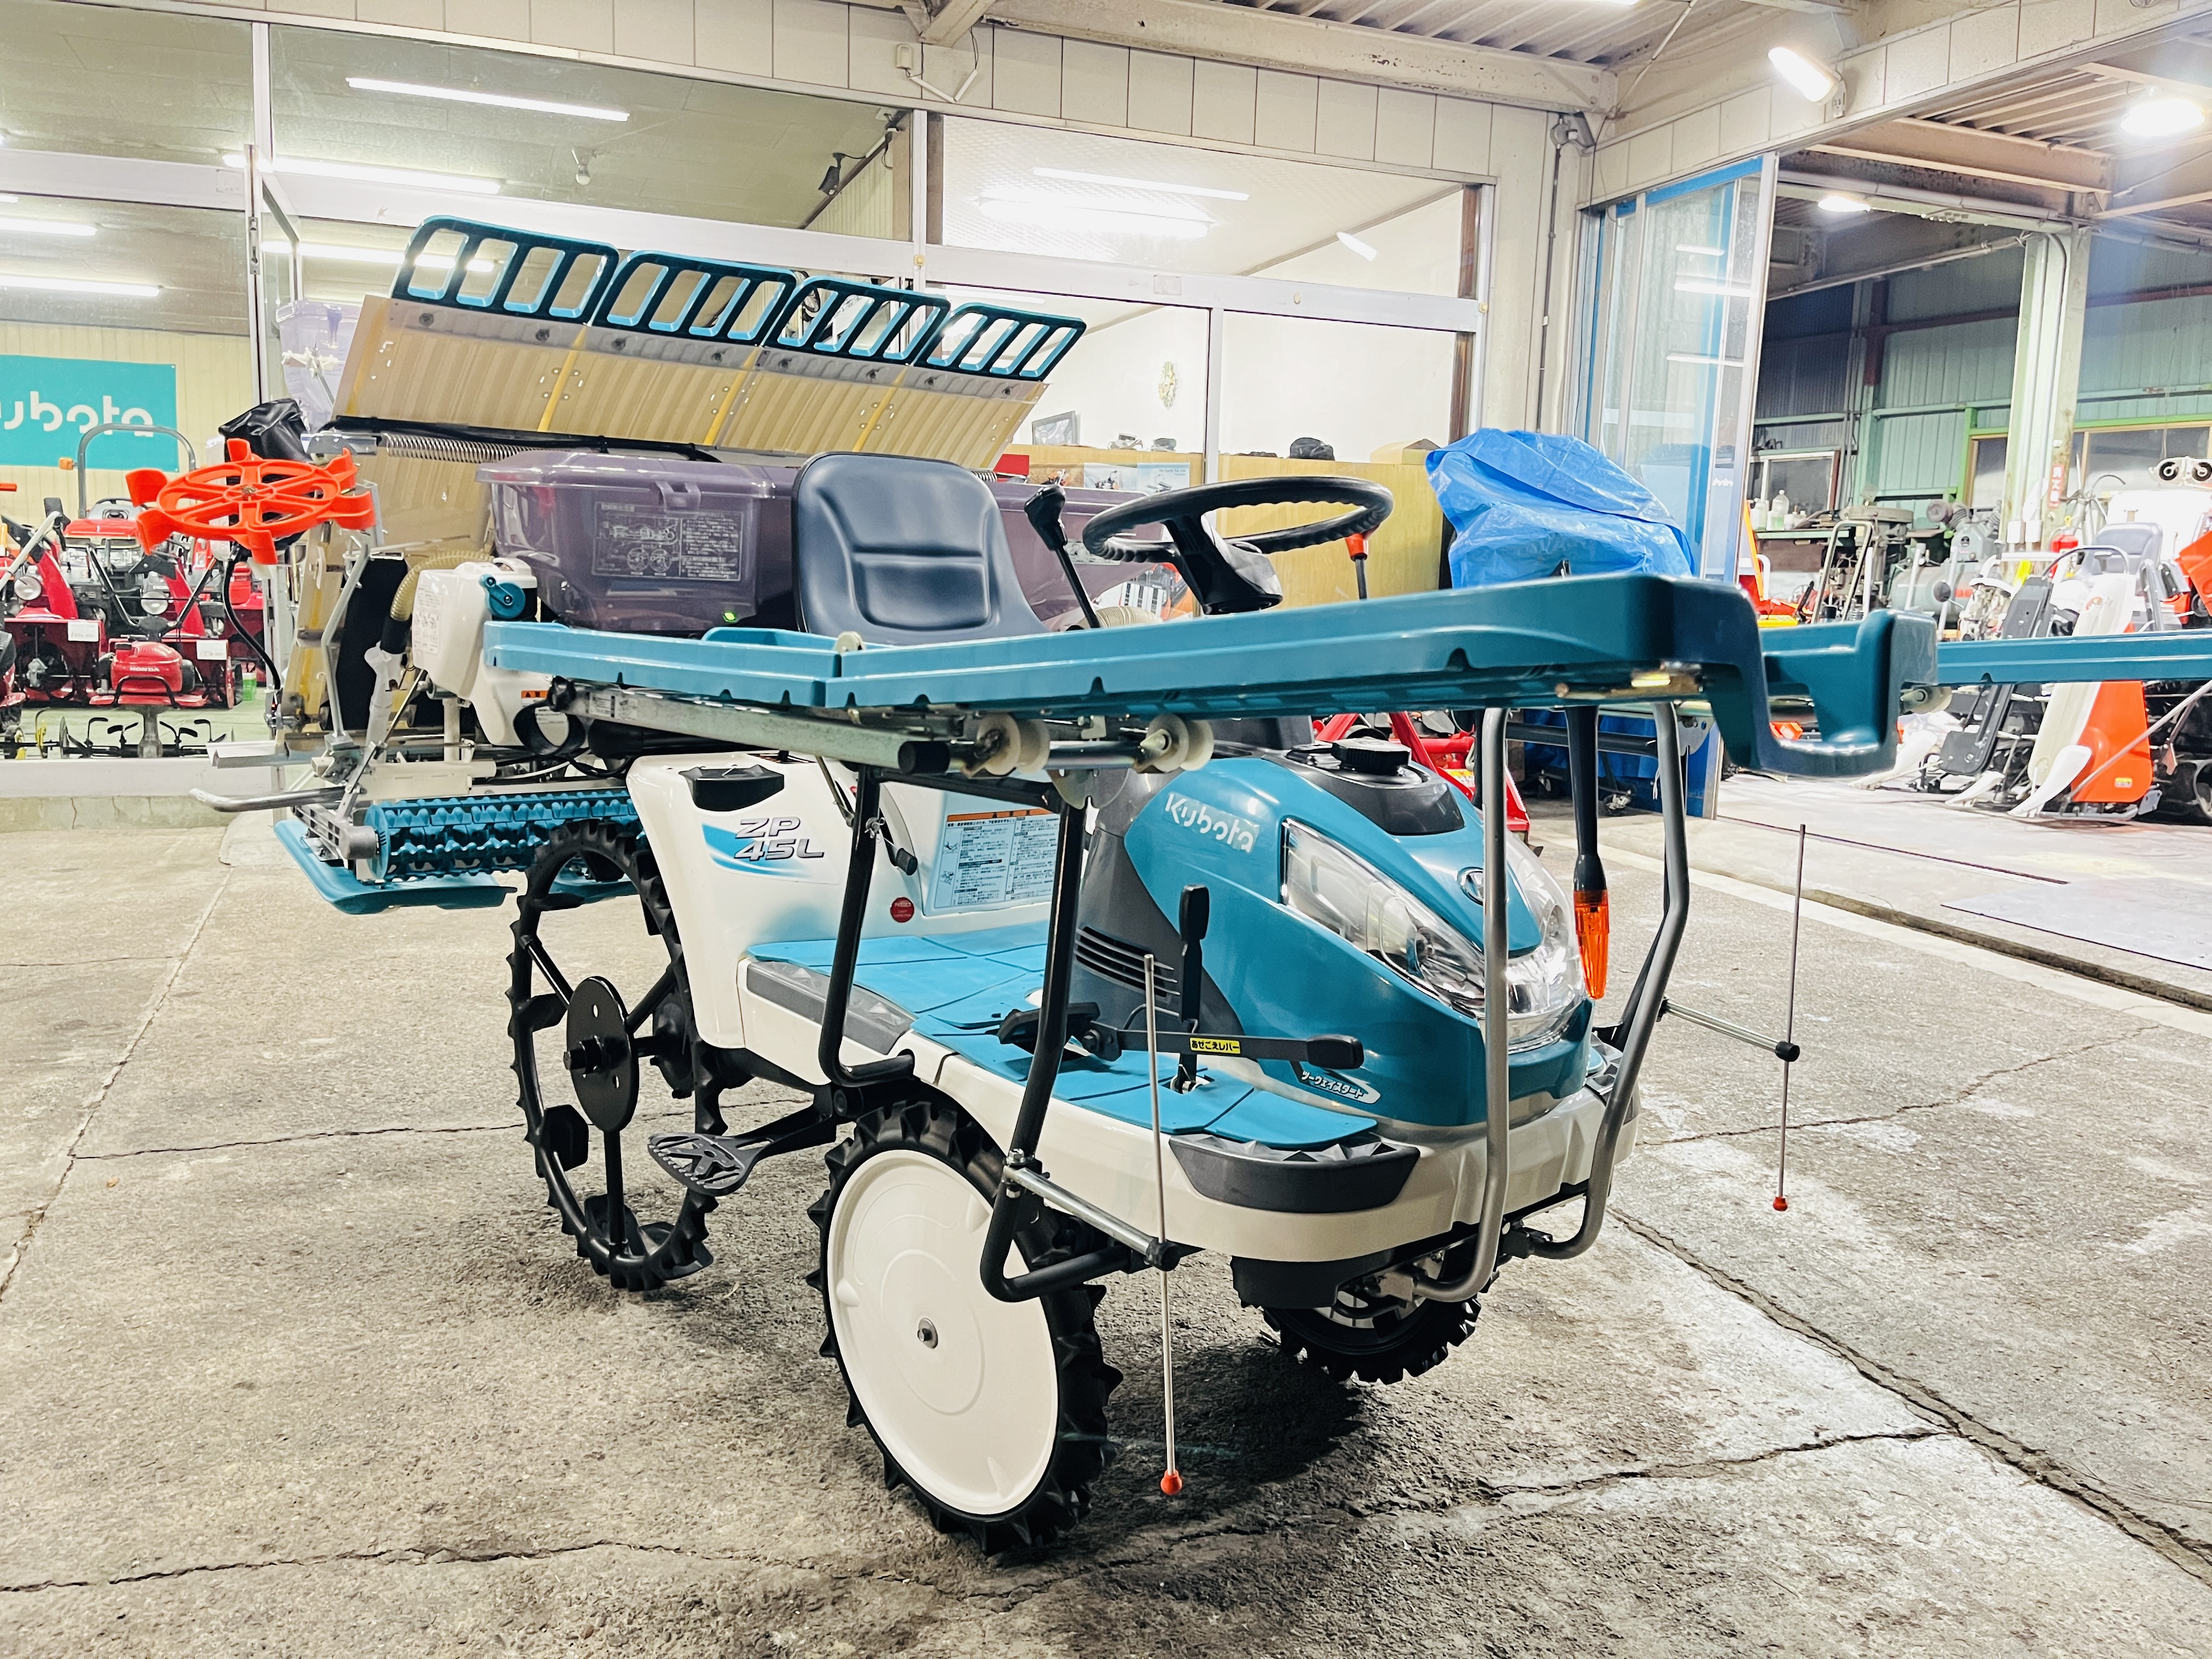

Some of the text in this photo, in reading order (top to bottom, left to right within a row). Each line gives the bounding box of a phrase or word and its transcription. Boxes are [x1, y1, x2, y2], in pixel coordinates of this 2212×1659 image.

[0, 391, 154, 437] ubota
[735, 816, 800, 839] ZP
[1165, 793, 1254, 853] Kubota
[734, 839, 825, 861] 45L
[1301, 1070, 1364, 1098] ツーウェイスタート
